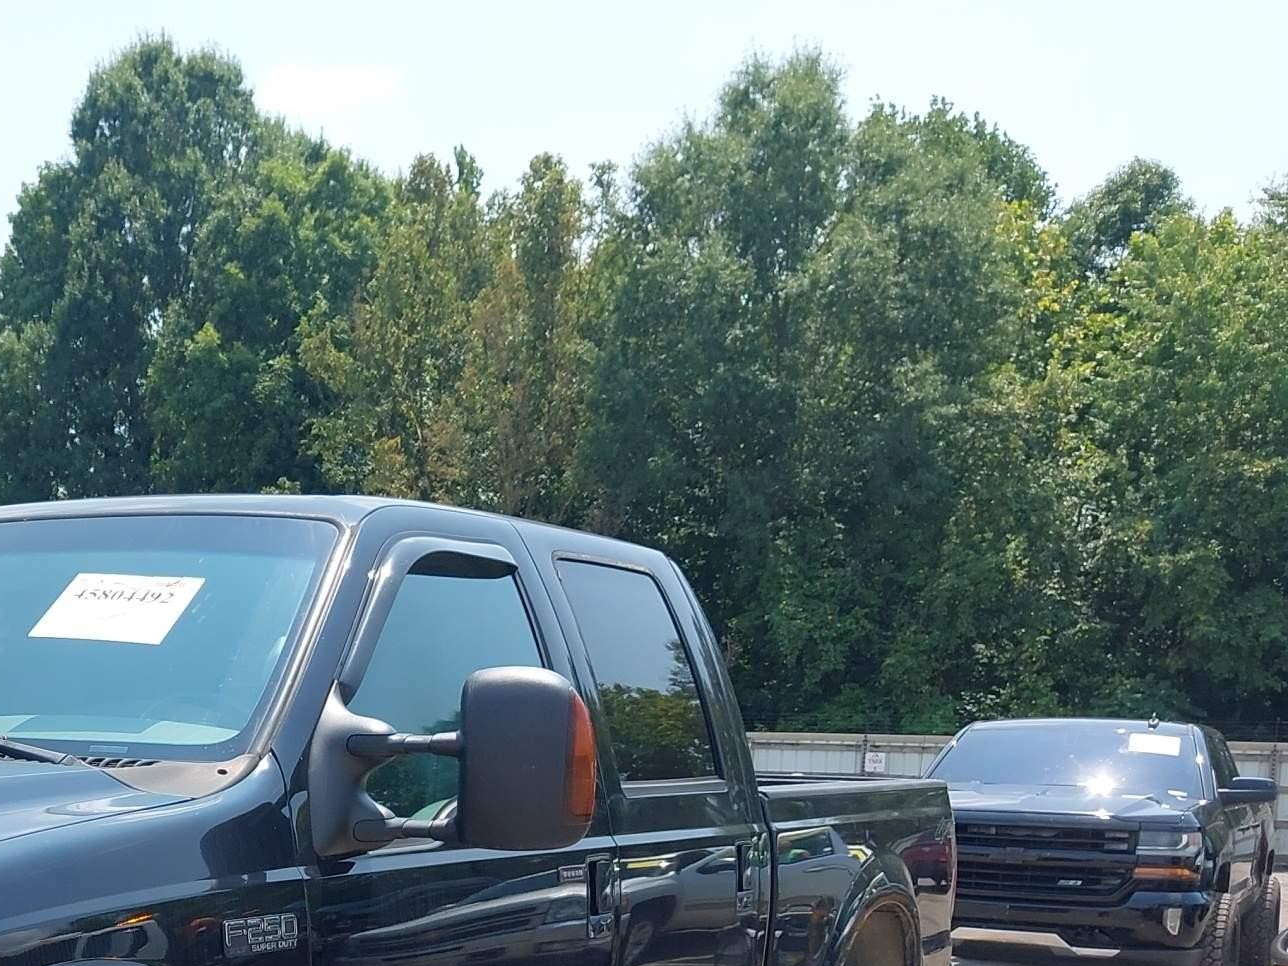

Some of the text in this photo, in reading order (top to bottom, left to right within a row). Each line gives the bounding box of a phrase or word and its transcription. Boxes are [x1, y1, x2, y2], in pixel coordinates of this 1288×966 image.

[74, 588, 175, 604] 45804492
[252, 939, 298, 952] SUPER DUTY
